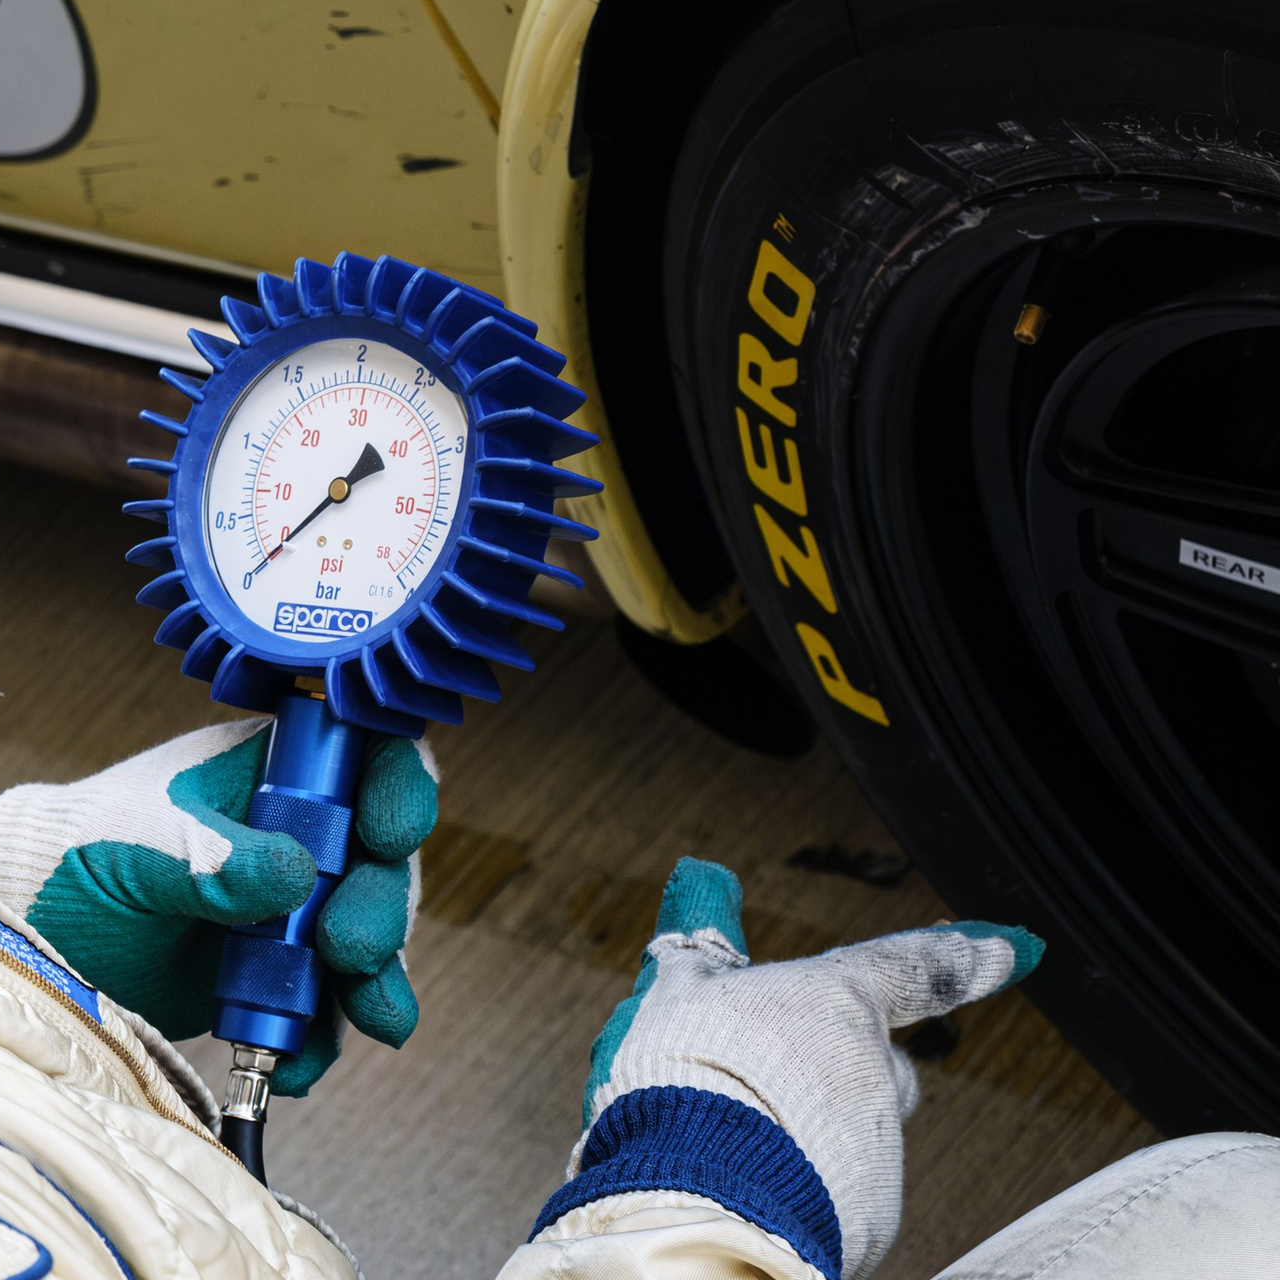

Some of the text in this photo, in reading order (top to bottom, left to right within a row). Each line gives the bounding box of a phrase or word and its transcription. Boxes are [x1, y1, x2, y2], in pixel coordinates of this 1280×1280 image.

[357, 344, 367, 362] 2
[348, 408, 368, 427] 30
[735, 239, 838, 614] ZERO
[243, 432, 250, 449] 1
[300, 429, 321, 448] 20
[455, 435, 465, 454] 3
[388, 439, 408, 458] 40
[274, 482, 292, 501] 10
[395, 496, 415, 515] 50
[376, 545, 391, 559] 58
[320, 555, 344, 575] psi
[1192, 548, 1266, 584] REAR
[242, 572, 253, 590] 0
[315, 581, 341, 600] bar
[276, 605, 370, 632] sparco
[796, 622, 890, 727] P
